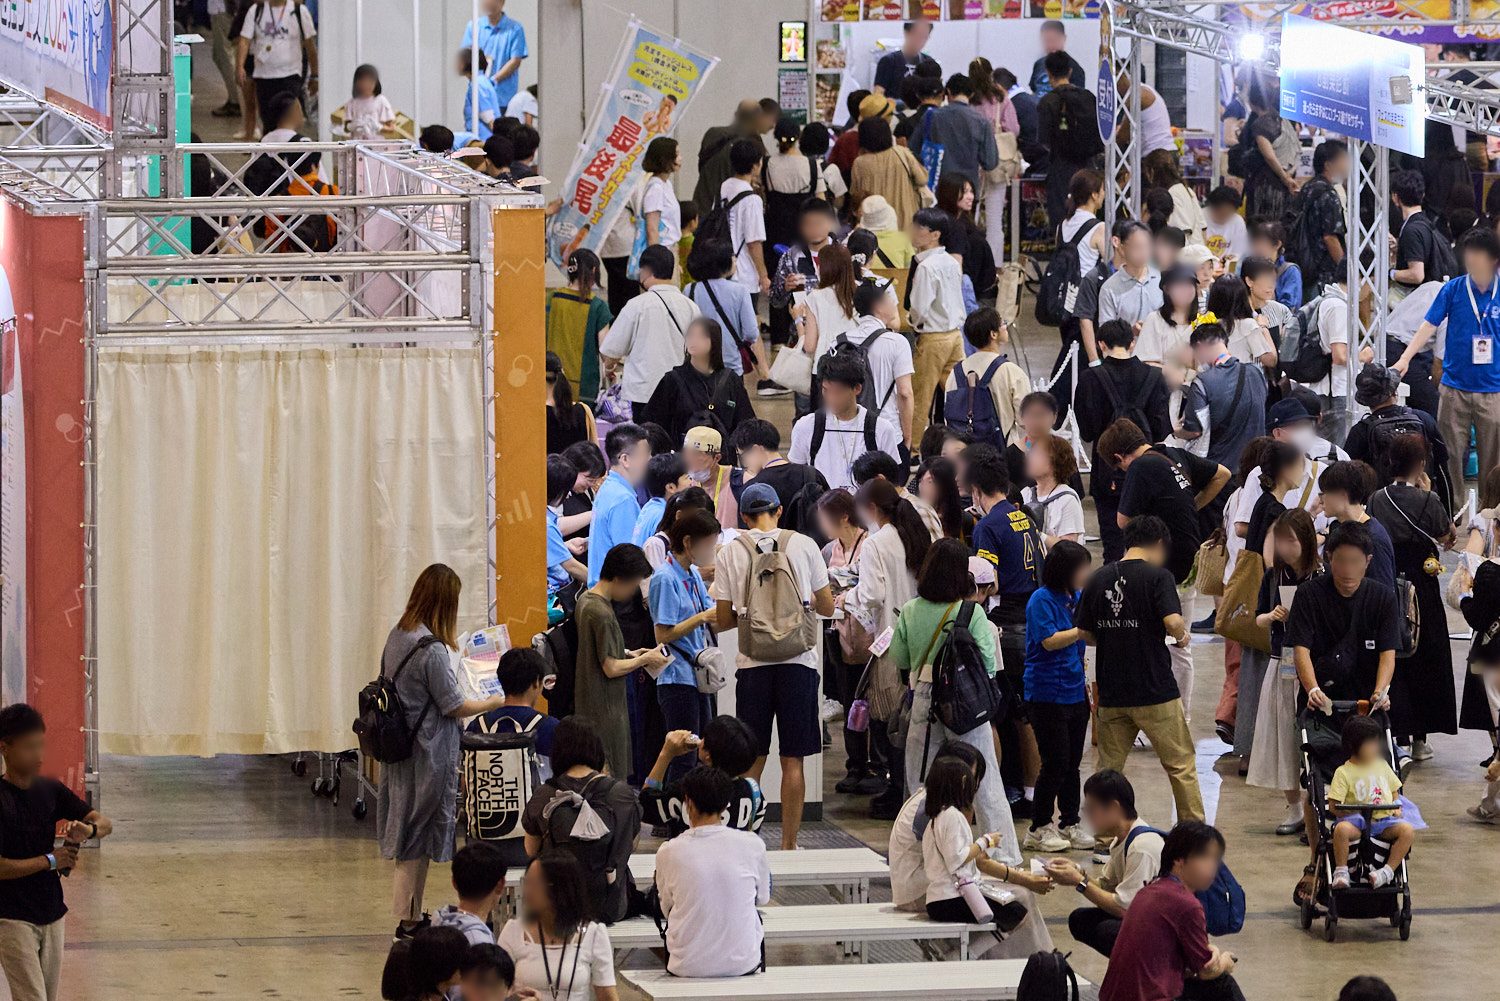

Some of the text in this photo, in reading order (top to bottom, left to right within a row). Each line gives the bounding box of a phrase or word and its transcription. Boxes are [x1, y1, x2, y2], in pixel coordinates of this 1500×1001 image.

[569, 114, 643, 216] 最後尾
[1064, 280, 1080, 314] NIKE
[477, 769, 492, 811] FACE
[489, 752, 505, 811] NORTH
[504, 776, 519, 810] THE
